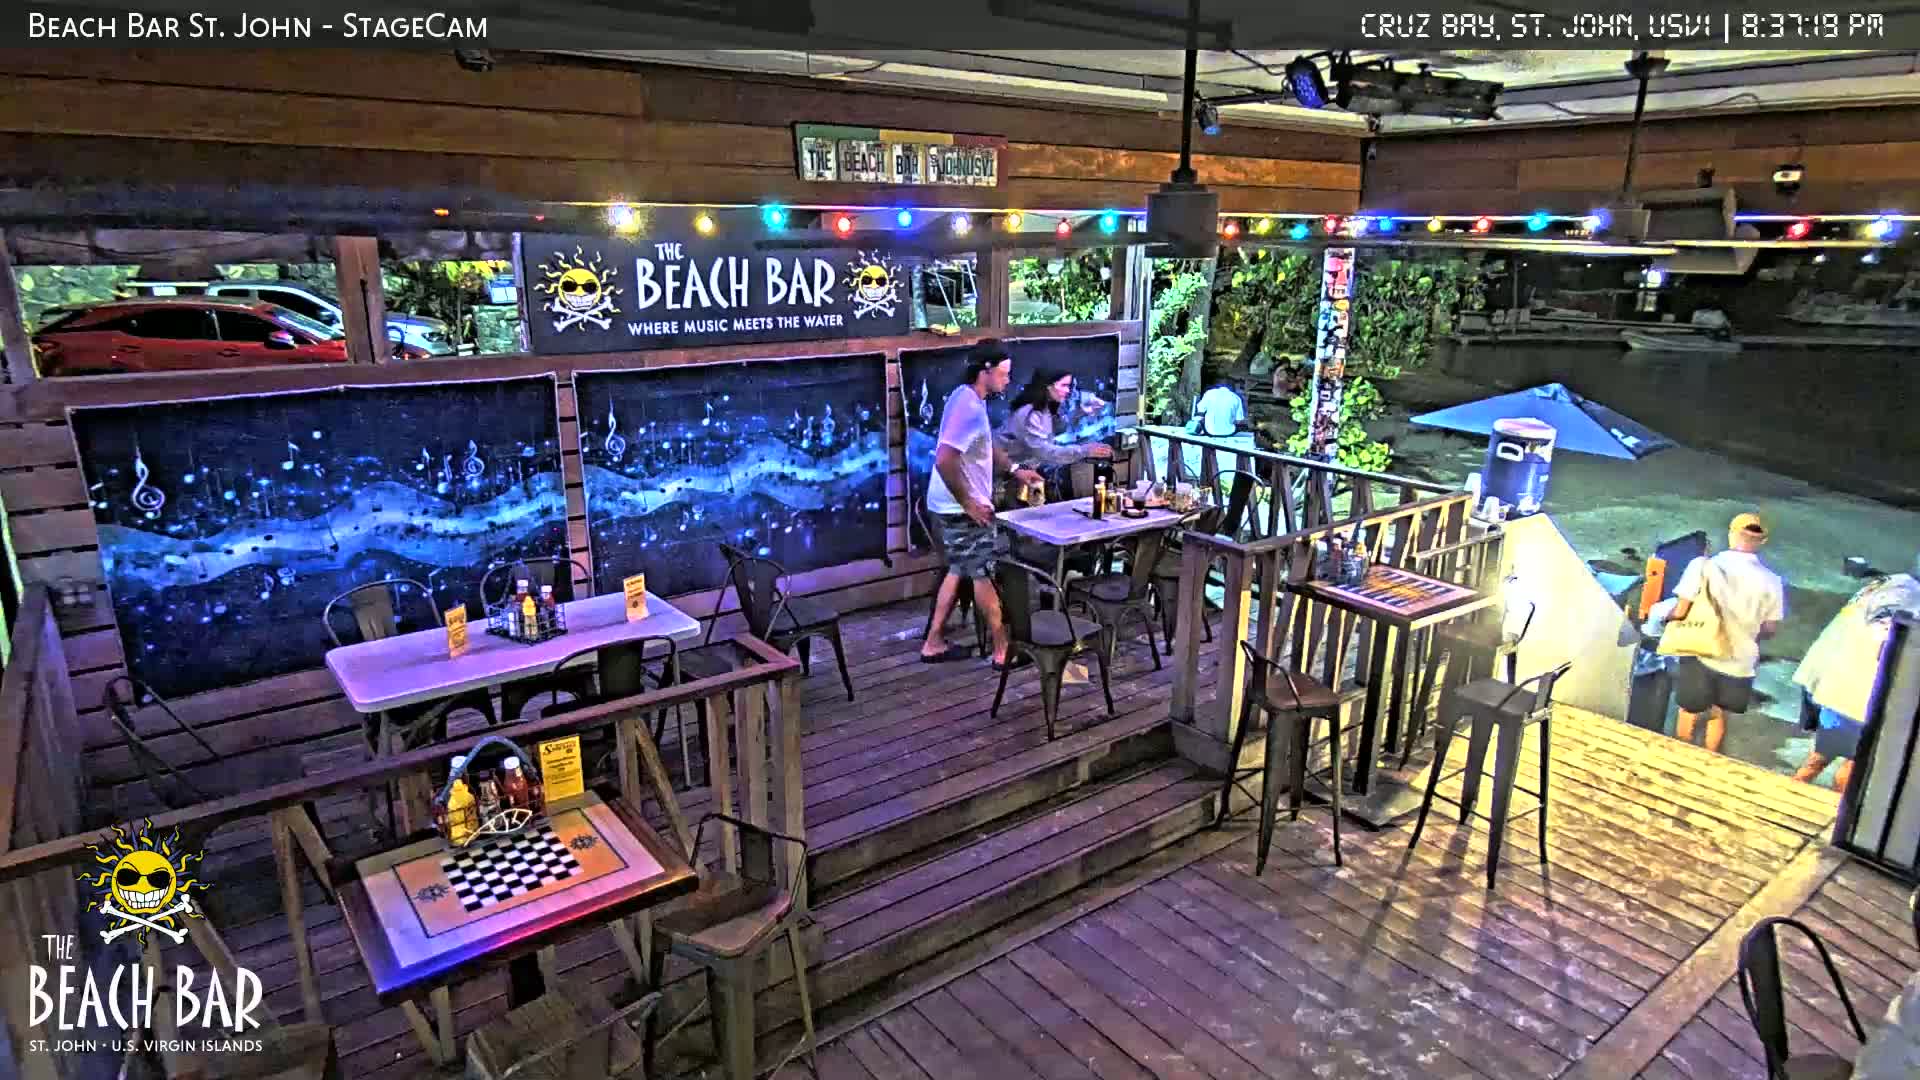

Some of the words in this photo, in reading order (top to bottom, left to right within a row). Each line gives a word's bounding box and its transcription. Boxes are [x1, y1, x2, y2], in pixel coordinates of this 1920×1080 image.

[809, 150, 831, 170] THE
[846, 150, 885, 173] BEACH
[896, 155, 919, 175] BAR
[655, 242, 684, 261] THE
[636, 256, 749, 310] BEACH
[766, 257, 835, 307] BAR
[627, 319, 679, 336] WHERE
[684, 318, 728, 333] MUSIC
[733, 317, 773, 332] MEETS
[777, 315, 801, 331] THE
[803, 314, 844, 329] WATER
